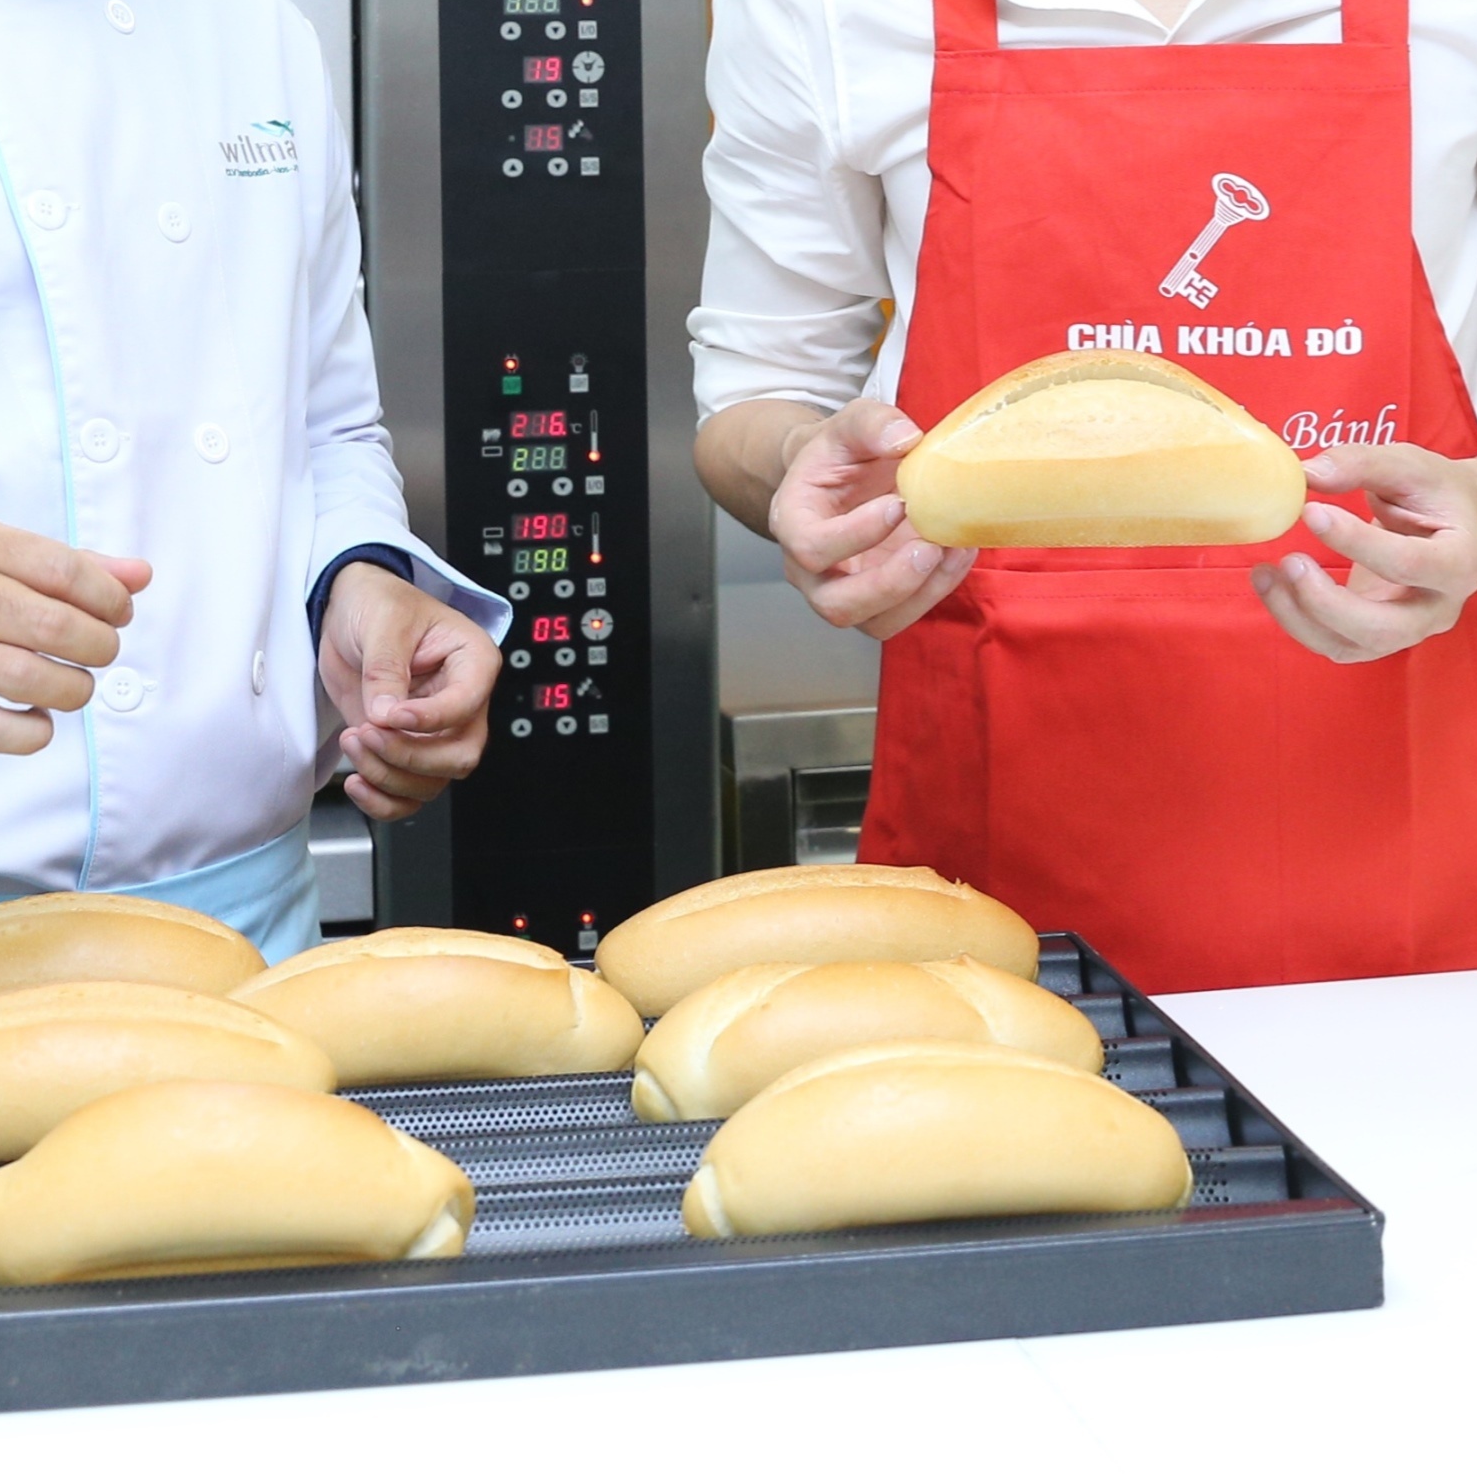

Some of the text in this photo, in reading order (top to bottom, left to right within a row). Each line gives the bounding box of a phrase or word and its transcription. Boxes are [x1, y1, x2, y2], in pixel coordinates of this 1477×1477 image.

[1067, 318, 1363, 357] CHÌA KHÓA ĐỎ
[1282, 403, 1397, 449] Bánh
